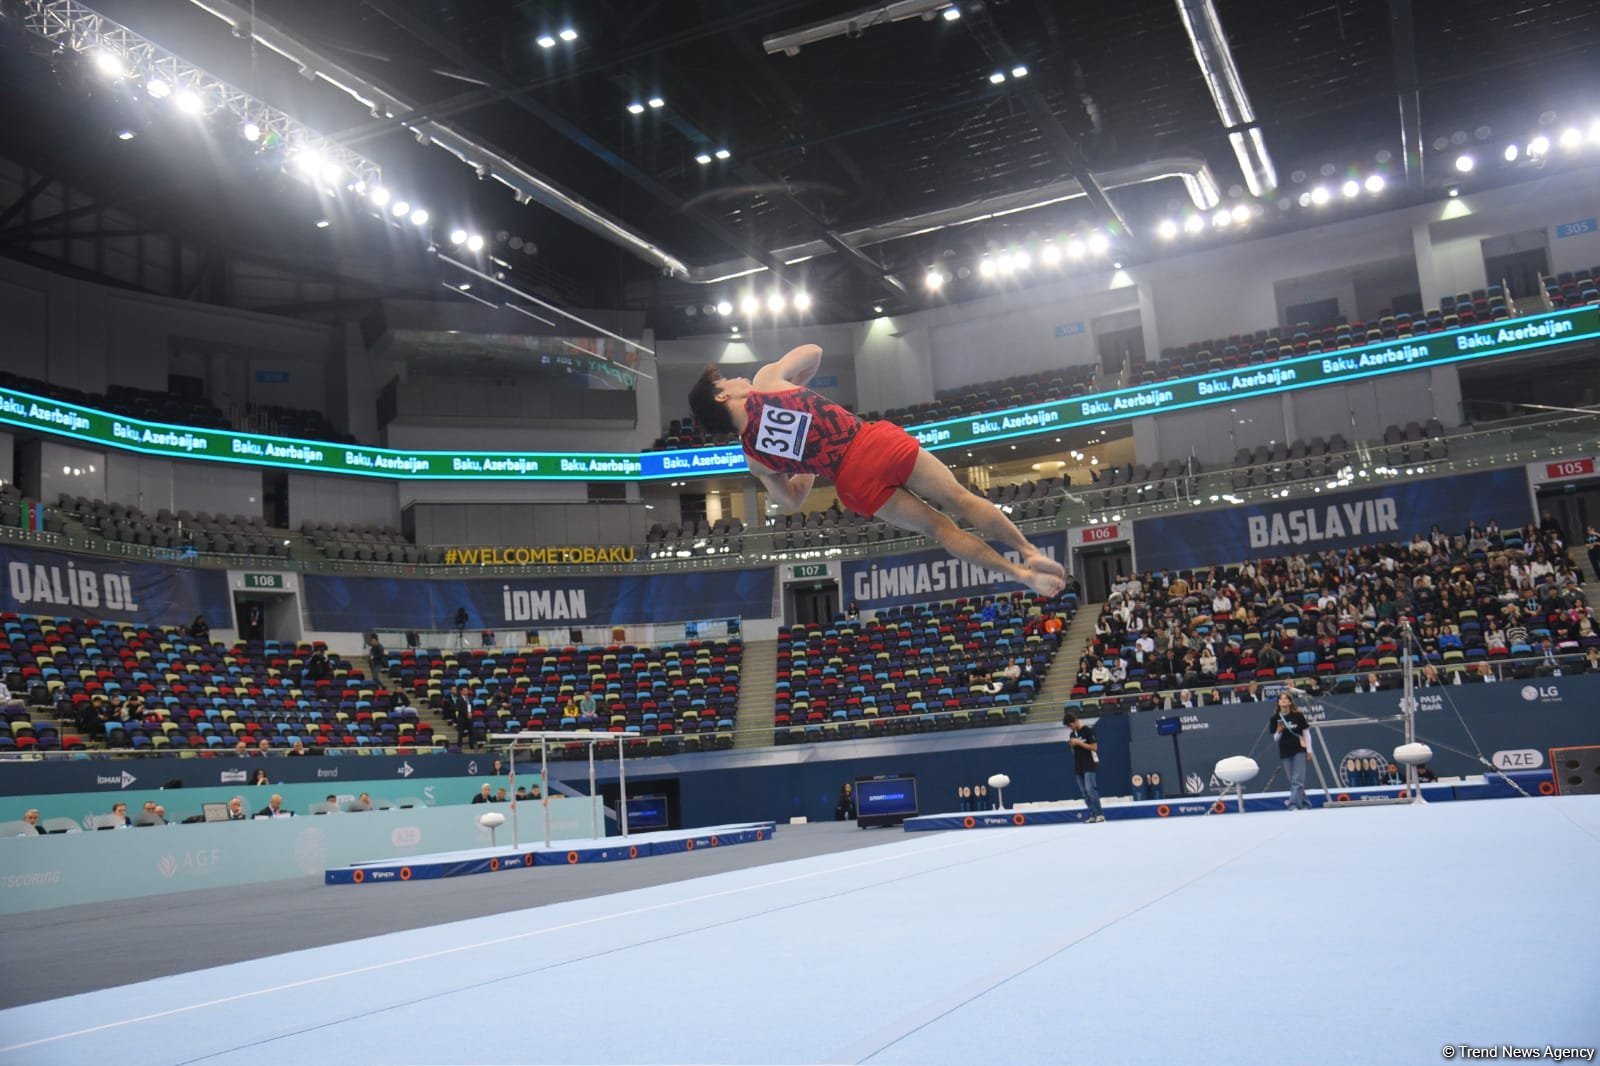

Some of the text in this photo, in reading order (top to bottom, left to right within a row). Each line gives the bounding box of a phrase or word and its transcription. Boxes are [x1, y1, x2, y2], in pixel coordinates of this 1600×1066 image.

[1457, 319, 1573, 349] Baku, Azerbaijan
[1322, 345, 1428, 373] Baku, Azerbaijan
[1198, 368, 1296, 395] Baku, Azerbaijan
[1081, 390, 1173, 415] Baku, Azerbaijan
[29, 403, 90, 430] Azerbaijan
[972, 411, 1058, 434] Baku, Azerbaijan
[113, 422, 208, 450] Baku, Azerbaijan
[761, 409, 796, 452] 316
[232, 439, 323, 463] Baku, Azerbaijan
[345, 451, 429, 473] Baku, Azerbaijan
[663, 452, 745, 469] Baku, Azerbaijan
[453, 458, 538, 474] Baku, Azerbaijan
[561, 459, 642, 474] Baku, Azerbaijan
[1557, 462, 1583, 475] 105
[1090, 528, 1110, 540] 106
[1248, 498, 1399, 548] BAŞLAYIR
[445, 547, 635, 565] #WELCOMETOBAKU
[253, 576, 275, 586] 108
[801, 566, 819, 576] 107
[103, 573, 138, 611] OL
[503, 585, 587, 621] İDMAN
[1540, 686, 1559, 697] LG
[1502, 753, 1534, 766] AZE
